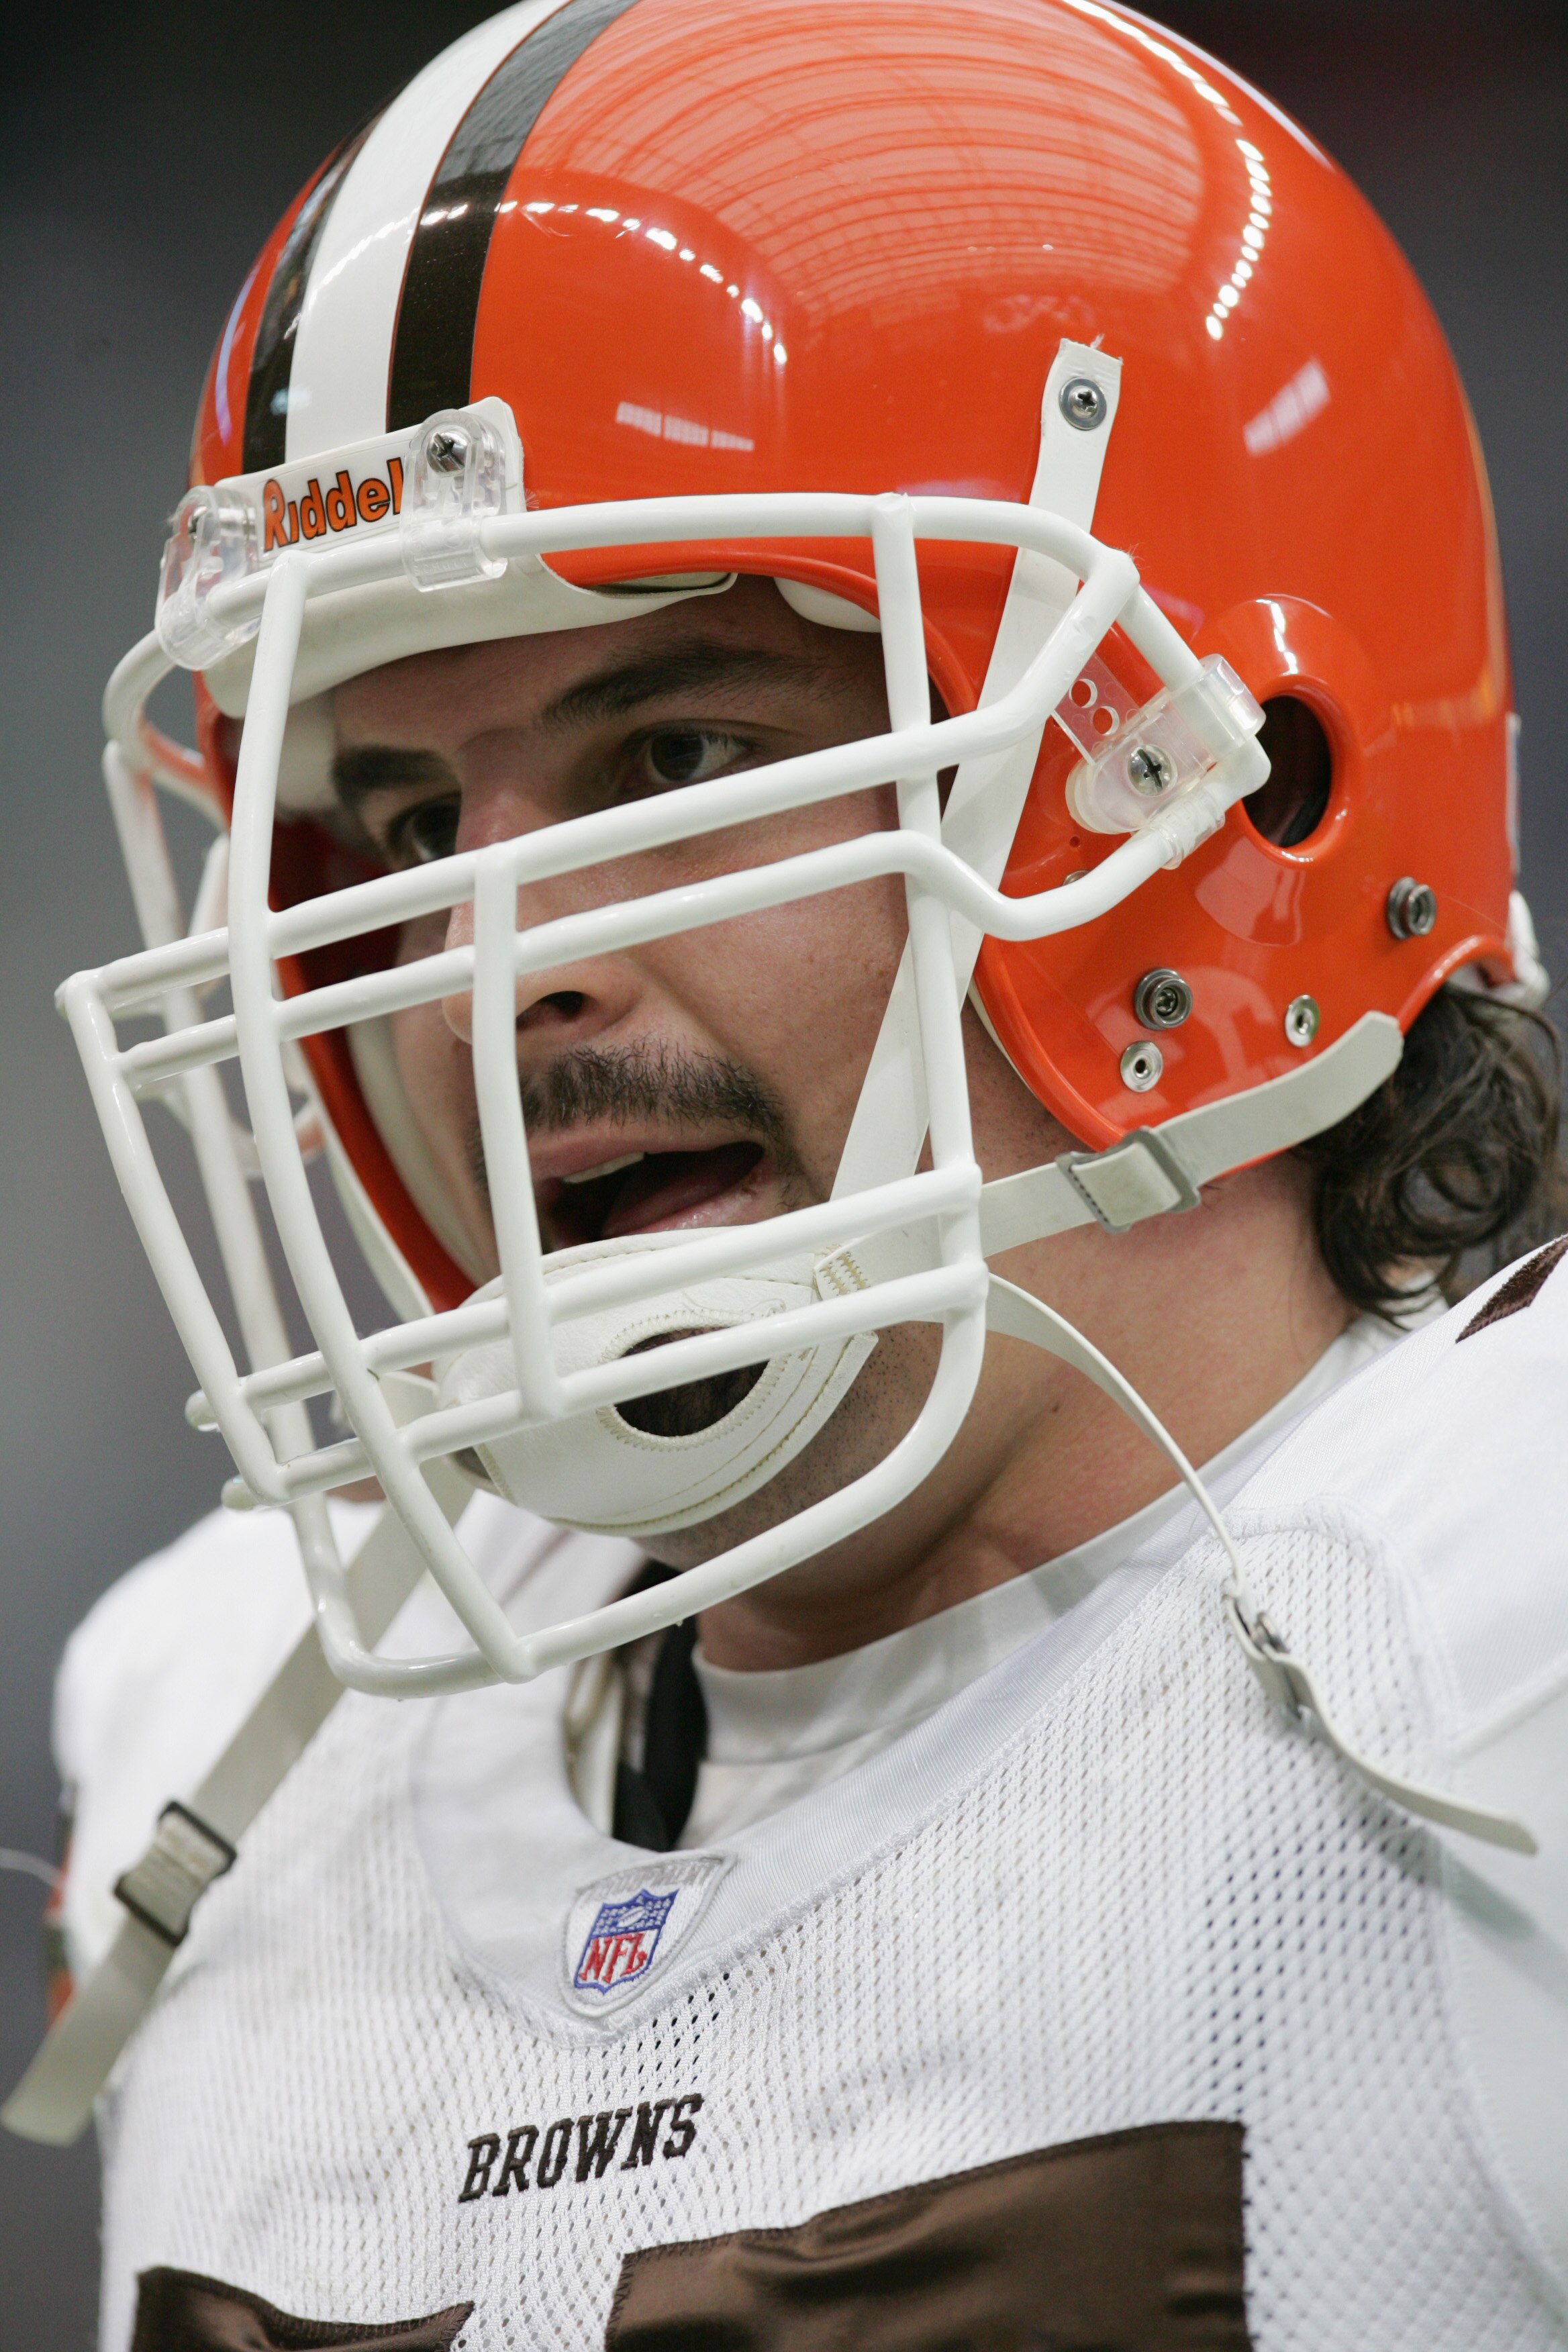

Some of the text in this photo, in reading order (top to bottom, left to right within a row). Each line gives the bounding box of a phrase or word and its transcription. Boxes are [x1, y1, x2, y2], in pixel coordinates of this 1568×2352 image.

[263, 457, 404, 552] Riddel
[578, 1932, 648, 1984] NFL
[458, 2092, 705, 2203] BROWNS
